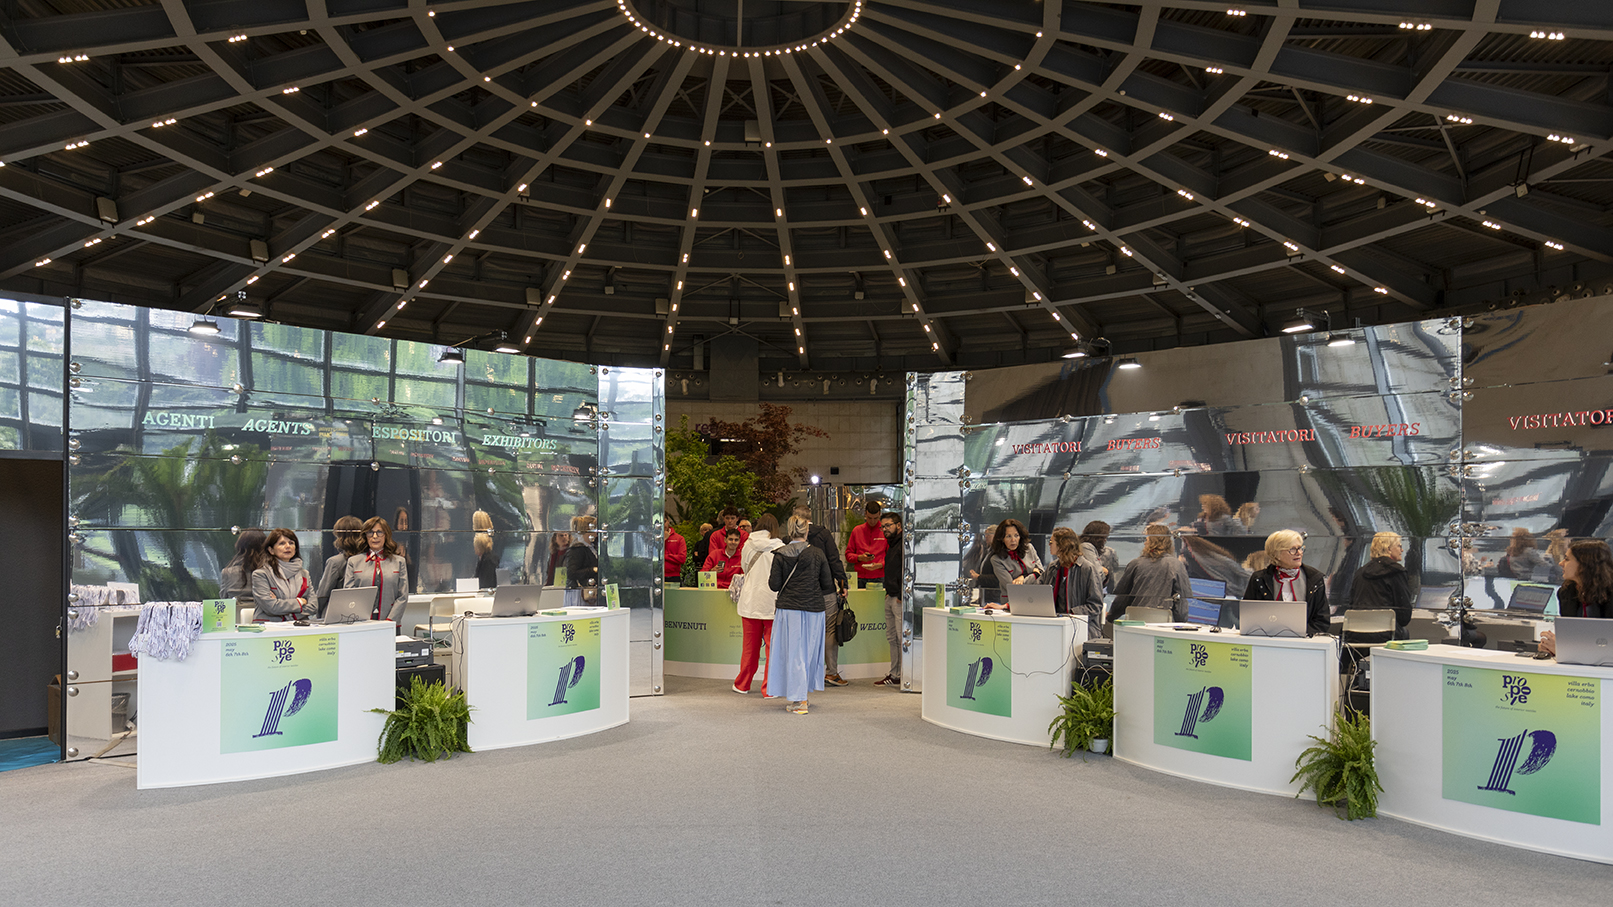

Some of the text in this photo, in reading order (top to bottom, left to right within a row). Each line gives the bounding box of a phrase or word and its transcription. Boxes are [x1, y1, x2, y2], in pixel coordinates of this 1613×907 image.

[142, 412, 215, 428] AGENTI
[242, 418, 313, 435] AGENTS
[1225, 422, 1420, 445] VISITATORI BUYERS
[371, 426, 557, 450] ESPOSITORI EXHIBITORS
[1012, 438, 1161, 454] VISITATORI BUYERS
[664, 620, 706, 630] BENVENUTI
